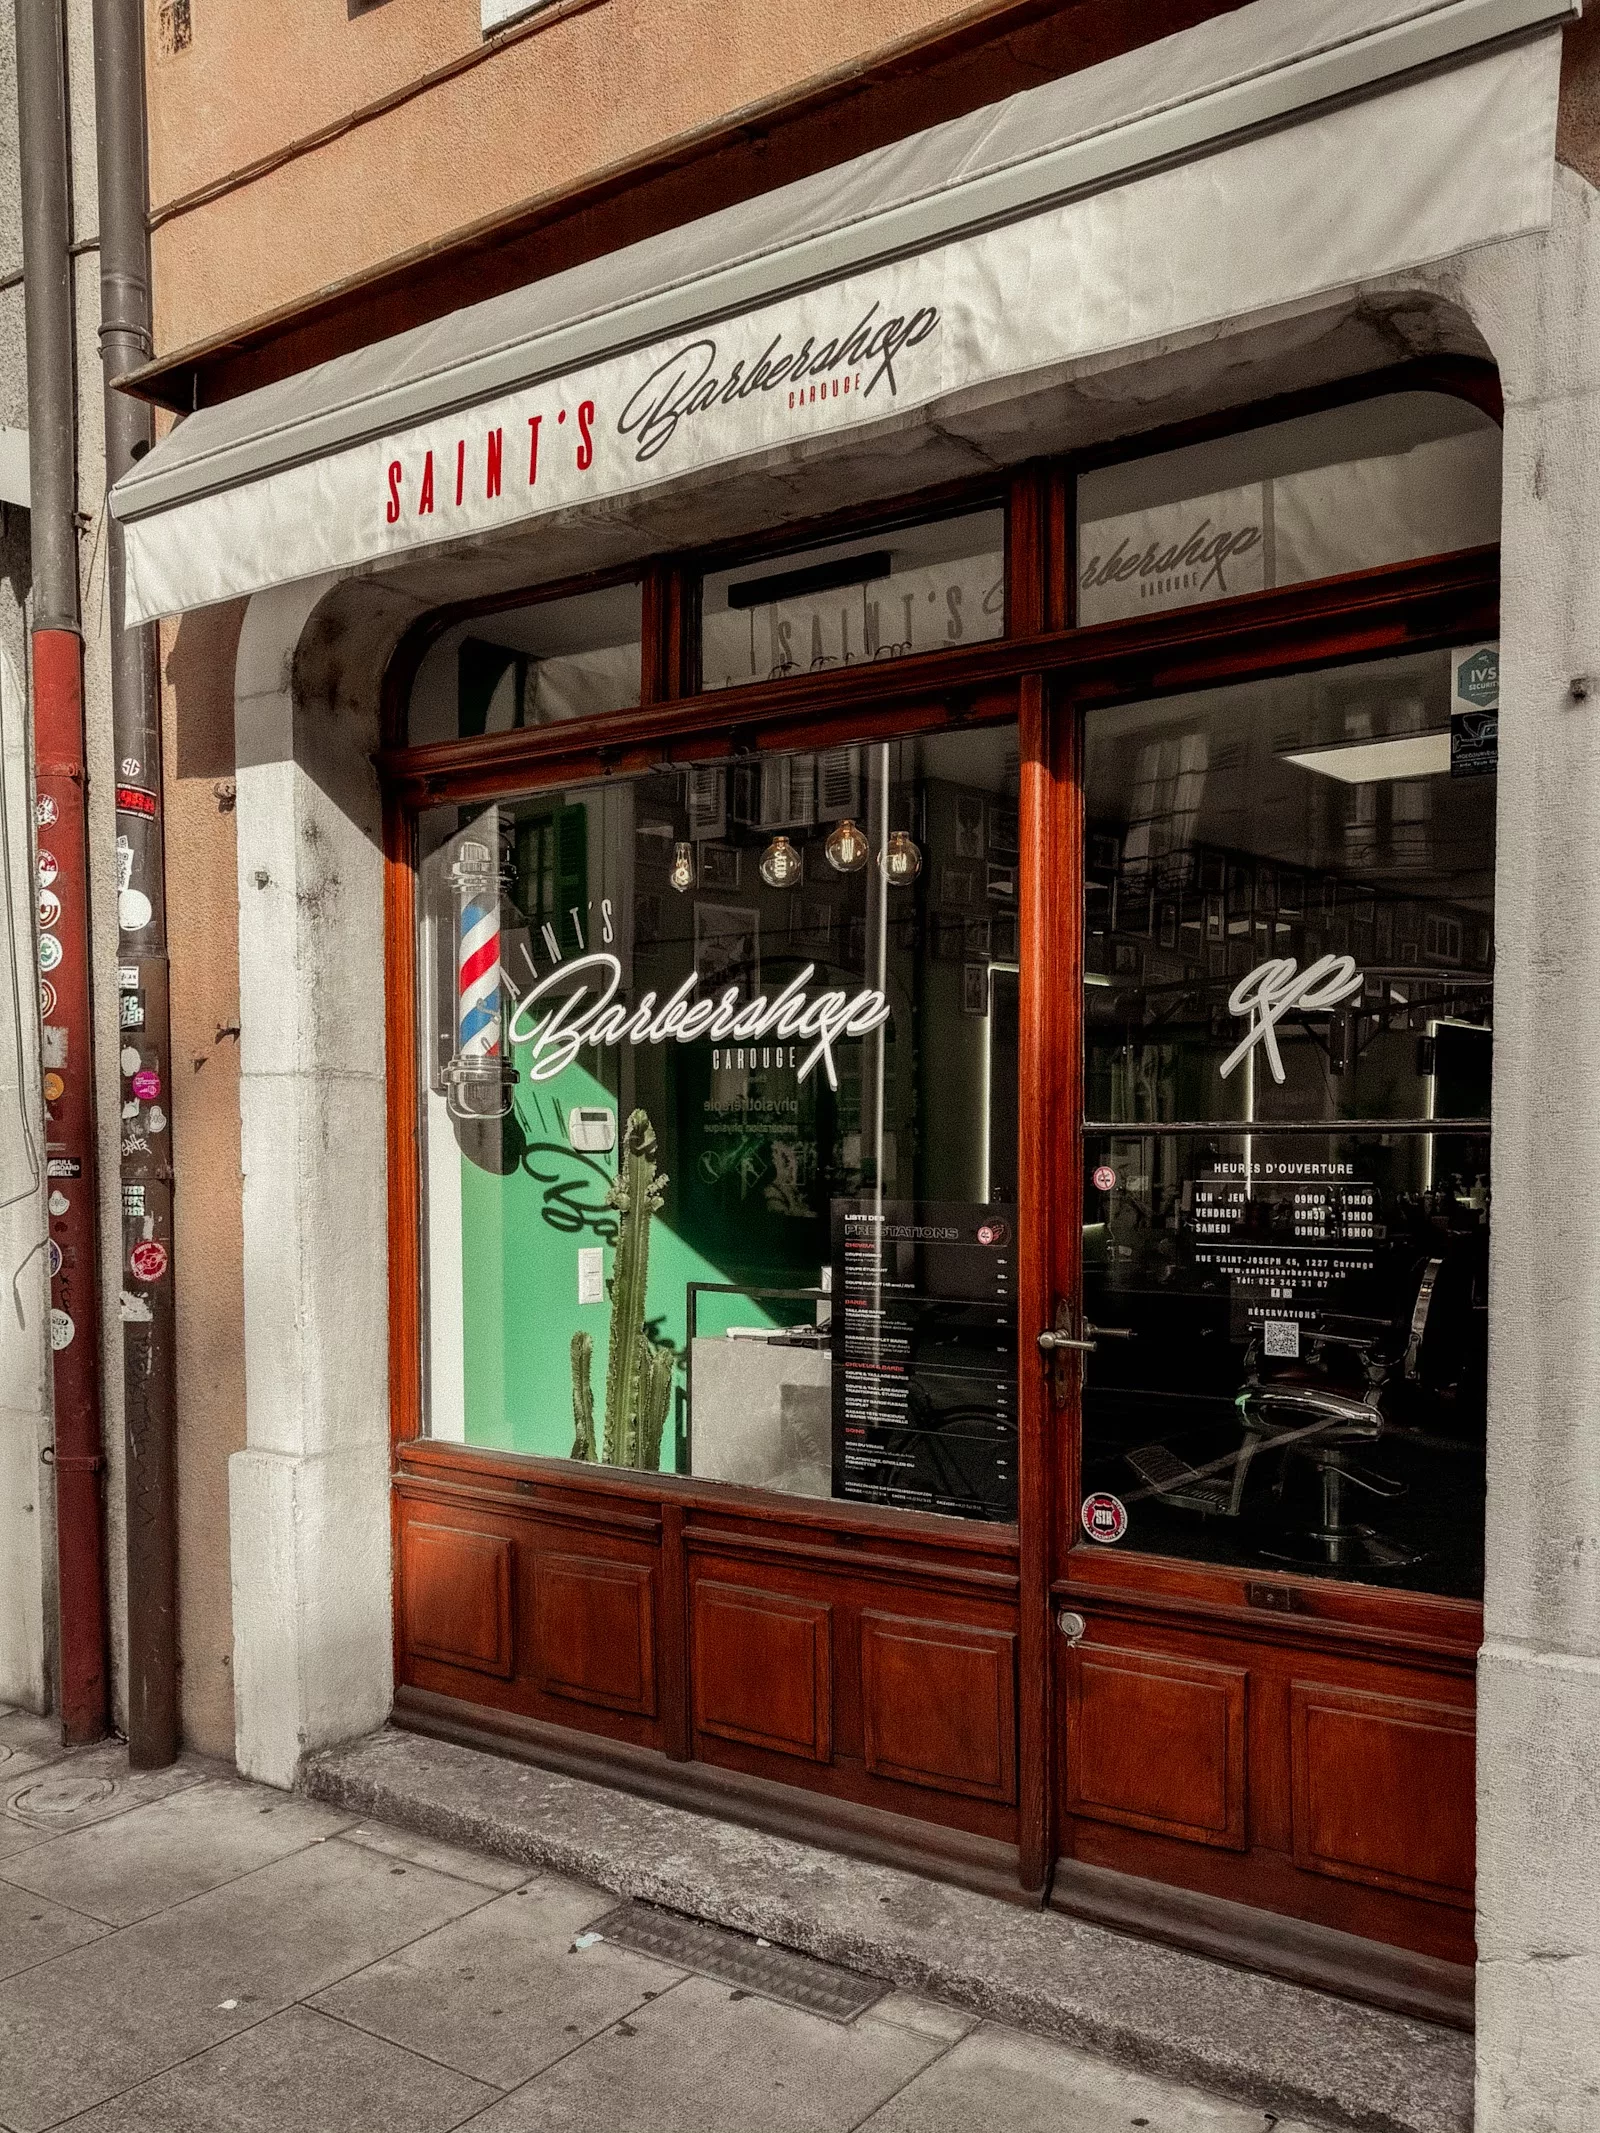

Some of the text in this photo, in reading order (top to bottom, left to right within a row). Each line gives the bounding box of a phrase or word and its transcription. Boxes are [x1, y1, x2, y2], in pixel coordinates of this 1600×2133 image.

[788, 373, 862, 409] CAROUGE
[387, 301, 940, 524] SAINT'S Barbershop
[1471, 667, 1497, 683] IVS
[508, 953, 890, 1091] Barbershop
[711, 1047, 796, 1070] CAROUGE
[1214, 1163, 1354, 1175] HEURES D'OUVERTURE
[1195, 1193, 1213, 1202] LUN
[1227, 1193, 1245, 1203] JEU
[1294, 1194, 1326, 1204] 09H00
[1341, 1195, 1373, 1205] 19H00
[1195, 1208, 1241, 1218] VENDREDI
[1294, 1210, 1326, 1220] 09H30
[1341, 1211, 1373, 1221] 19H00
[844, 1224, 959, 1239] PRESTATIONS
[1195, 1223, 1231, 1234] SAMEDI
[1294, 1226, 1326, 1236] 09H00
[1195, 1254, 1212, 1262] RUE
[1216, 1255, 1281, 1265] SAINT-JOSEPH
[1306, 1259, 1328, 1267] 1227
[1248, 1307, 1317, 1319] RÉSERVATIONS
[1096, 1510, 1112, 1525] SIR
